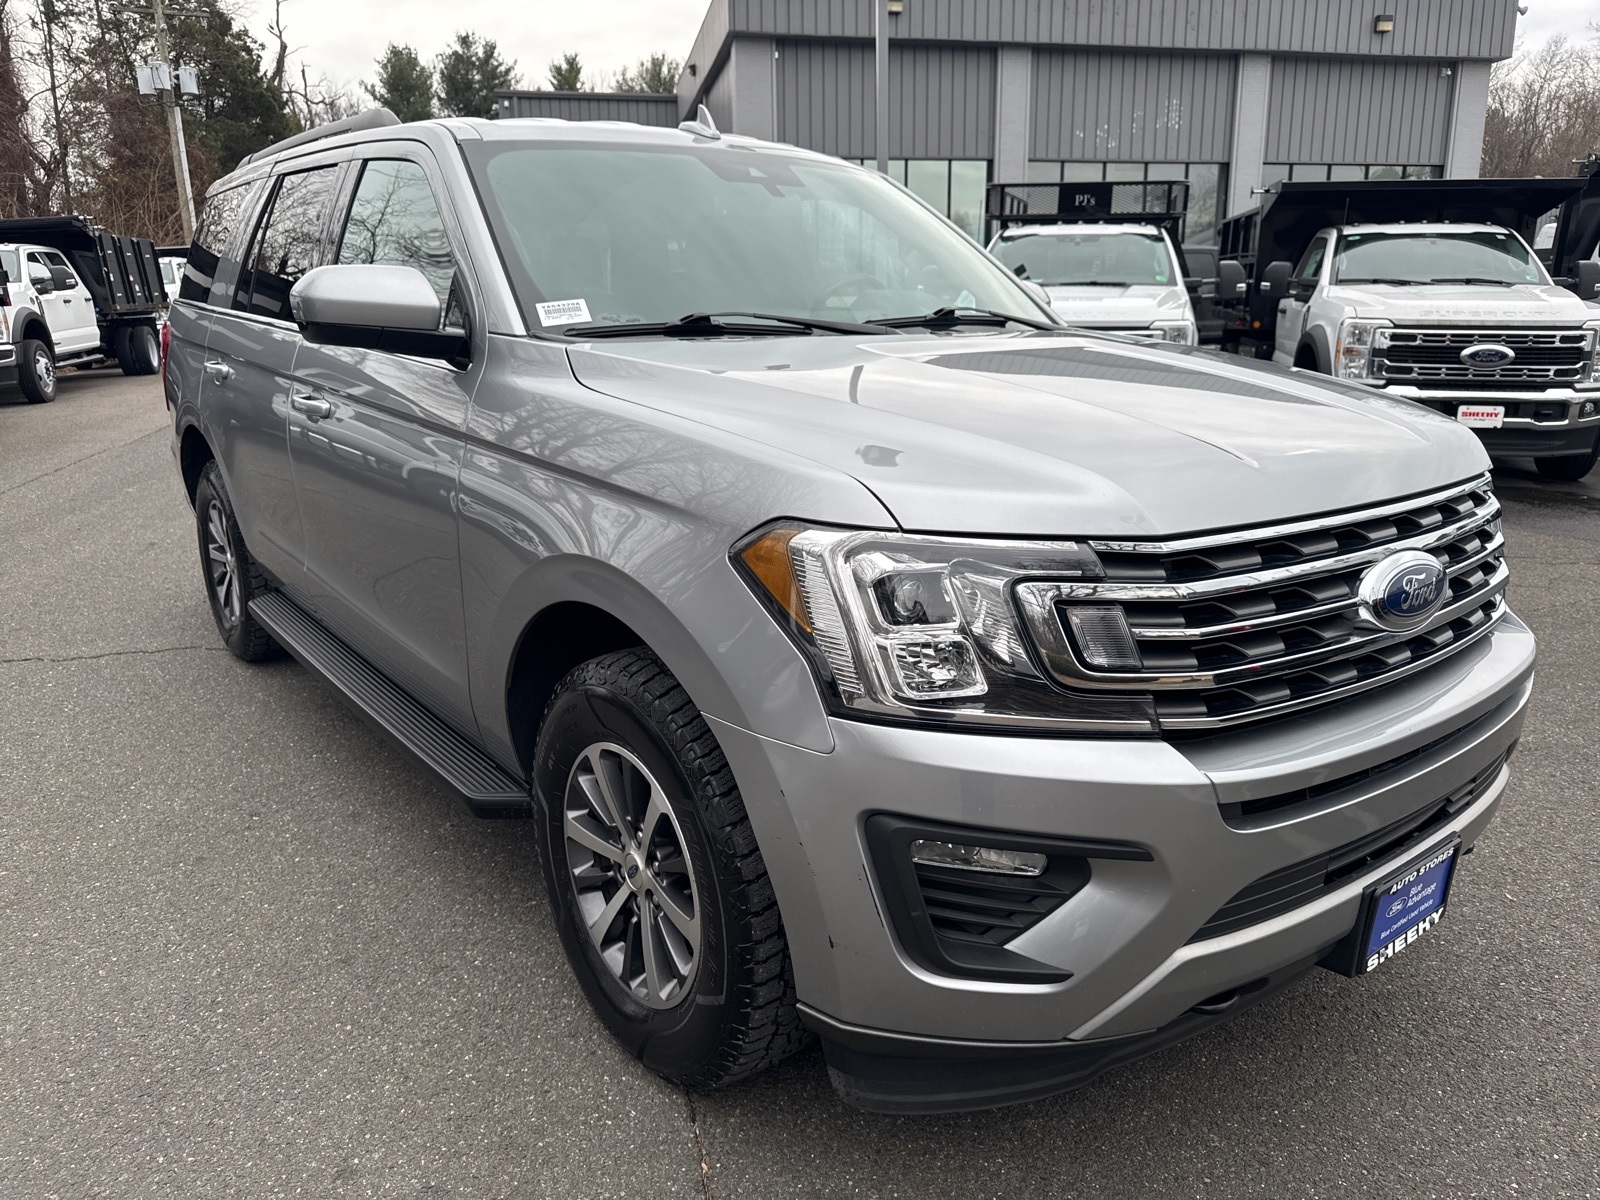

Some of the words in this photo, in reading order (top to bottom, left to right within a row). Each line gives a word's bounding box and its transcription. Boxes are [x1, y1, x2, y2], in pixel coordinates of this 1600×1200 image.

[1075, 194, 1096, 206] PJ's
[1475, 350, 1502, 362] Ford
[1400, 572, 1437, 611] Ford
[1390, 871, 1418, 895] AUTO
[1418, 847, 1454, 876] STORES
[1406, 882, 1437, 908] Advantage
[1409, 882, 1423, 897] Blue
[1366, 907, 1444, 972] SHEEHY
[1380, 929, 1390, 940] Blue
